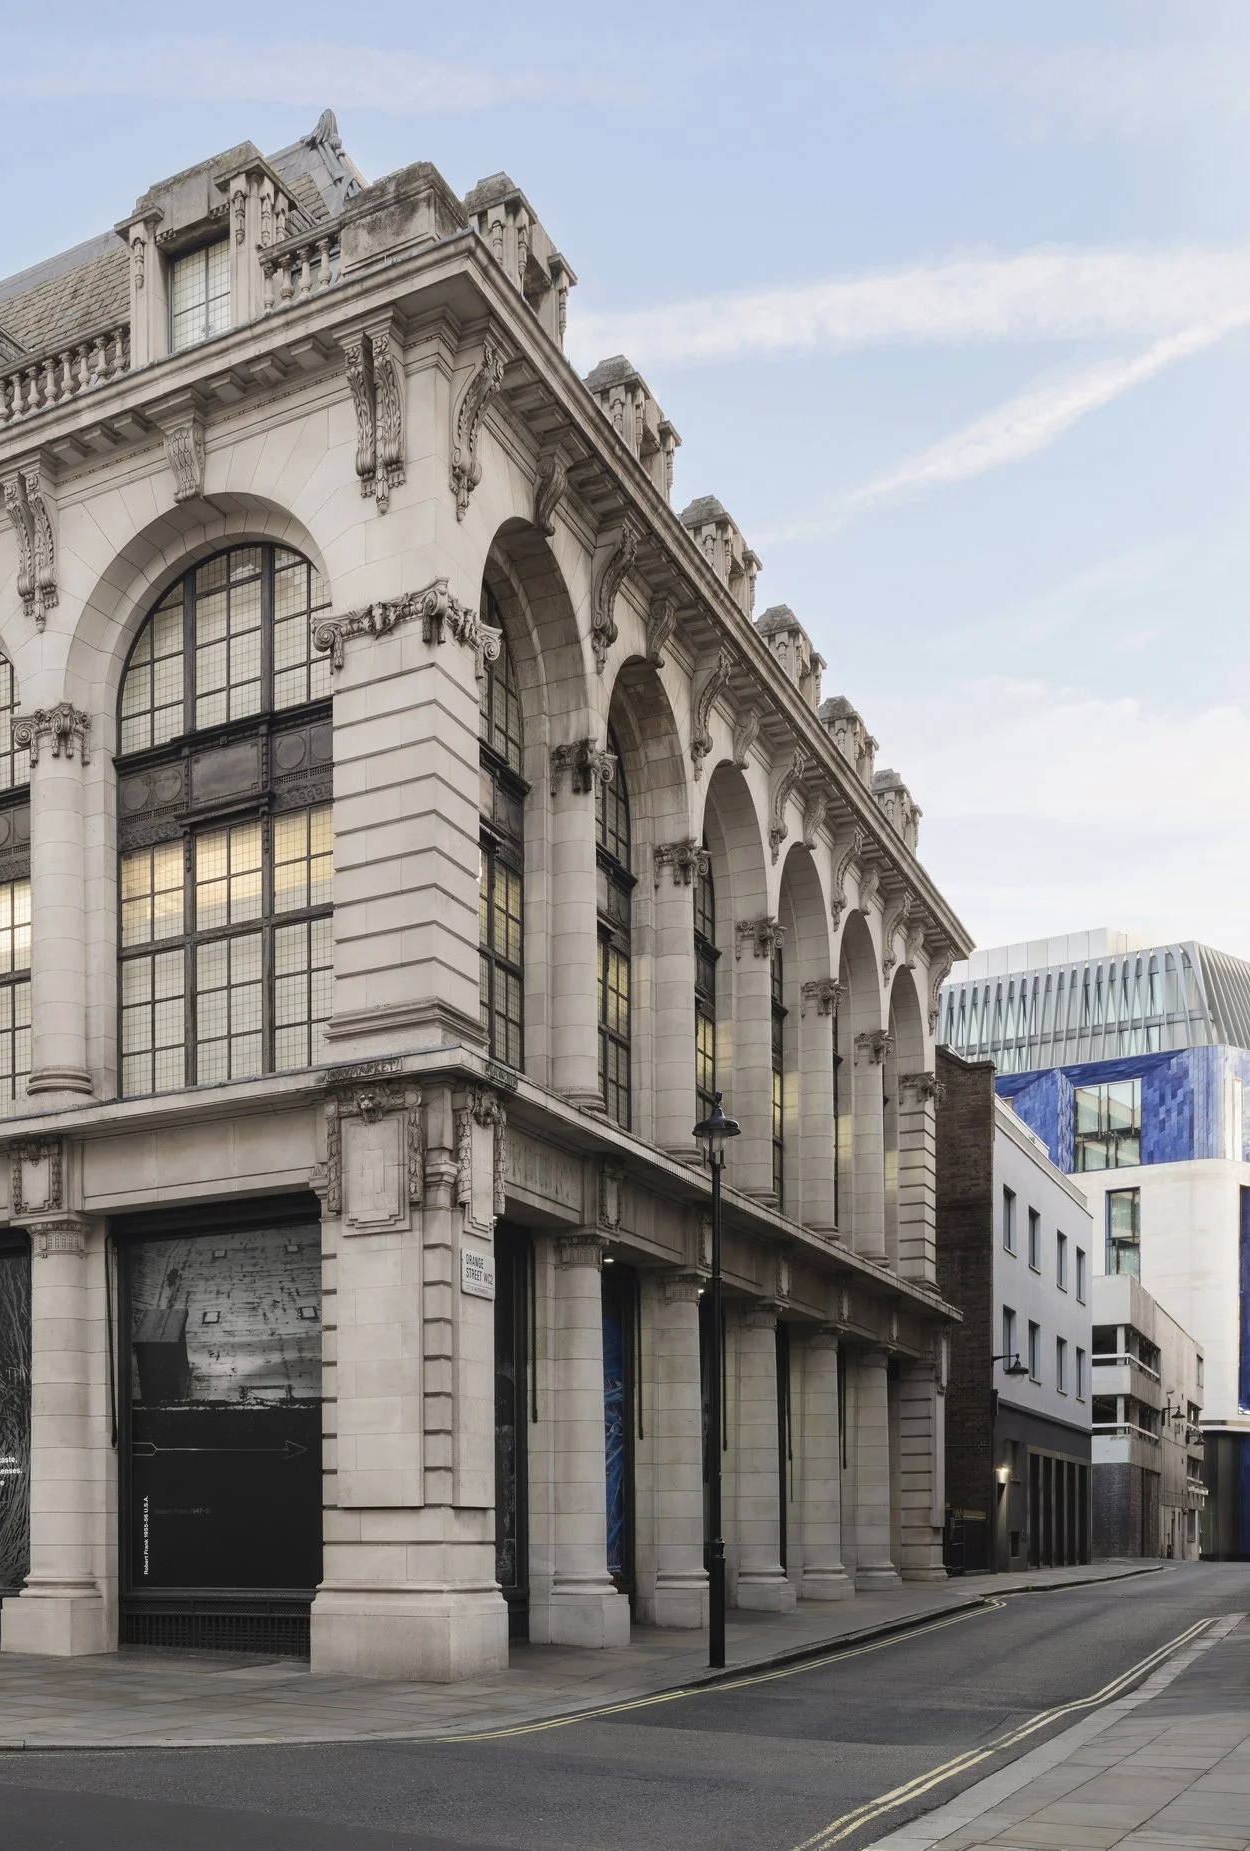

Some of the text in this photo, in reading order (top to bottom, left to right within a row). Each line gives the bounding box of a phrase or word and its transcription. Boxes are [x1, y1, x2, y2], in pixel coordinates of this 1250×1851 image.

[465, 1253, 484, 1270] ORANGE
[465, 1266, 493, 1285] STREET WC2
